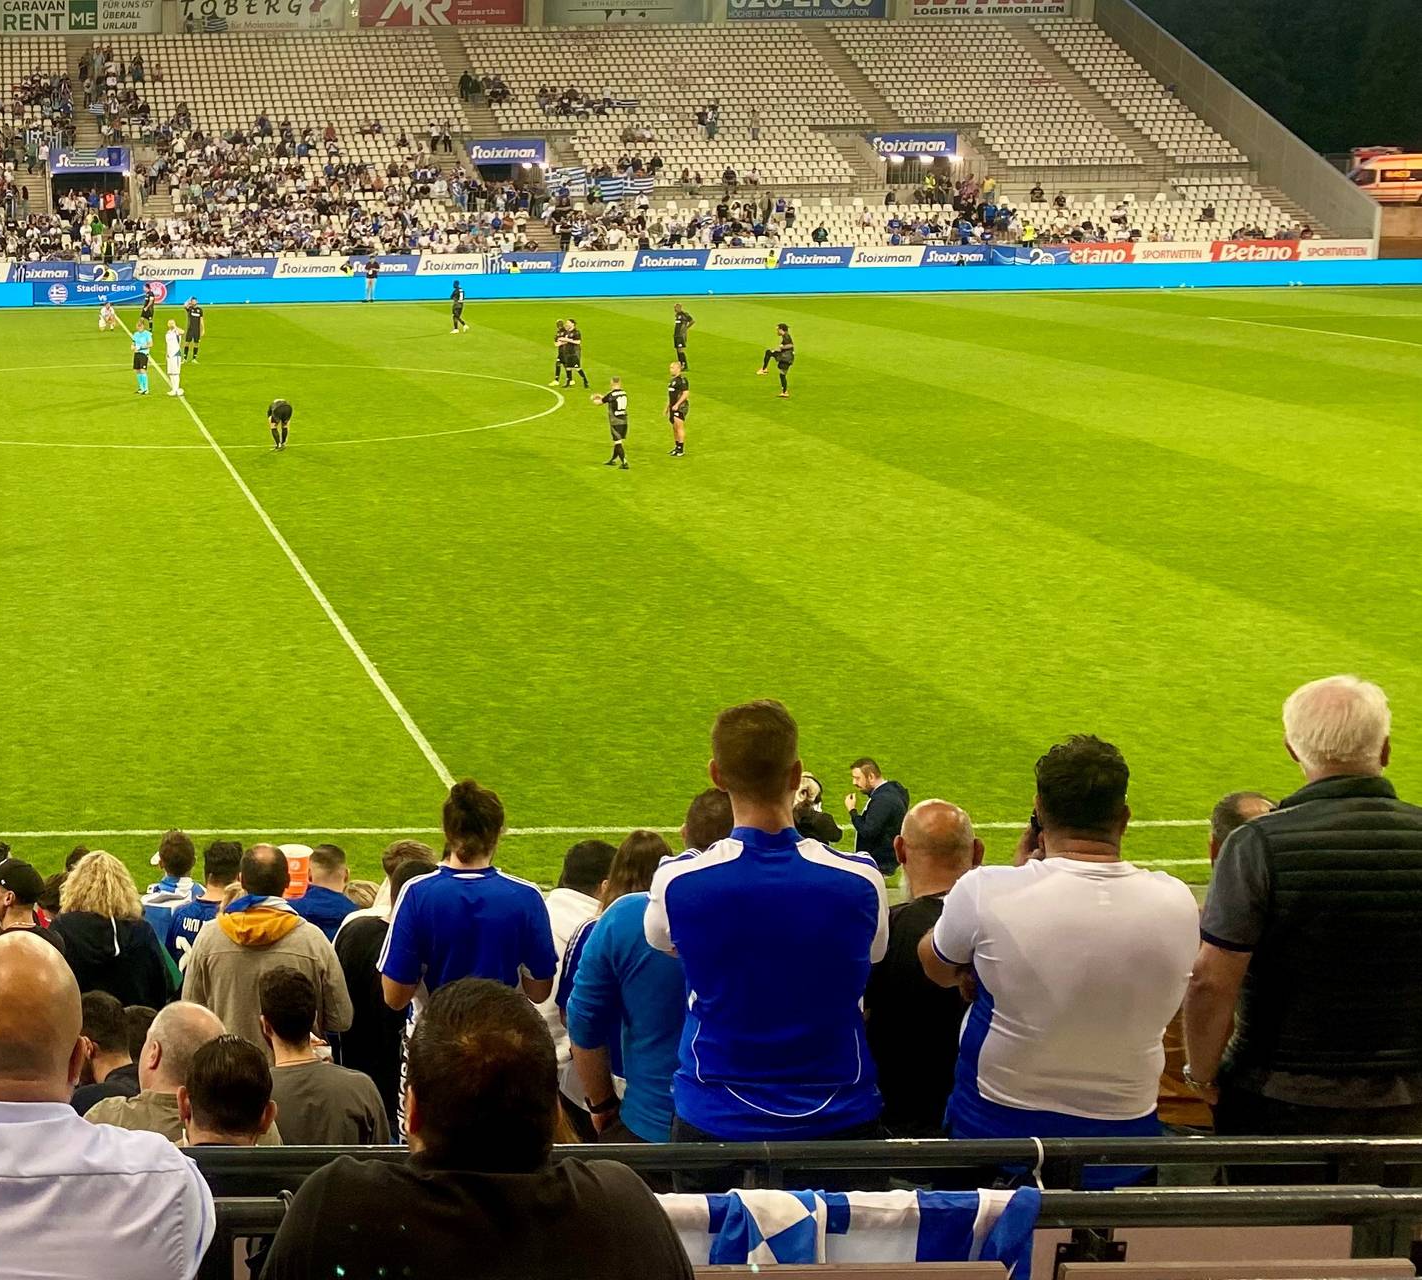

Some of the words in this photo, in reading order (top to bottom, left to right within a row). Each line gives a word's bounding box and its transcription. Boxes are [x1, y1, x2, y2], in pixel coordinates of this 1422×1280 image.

[3, 1, 65, 11] CARAVAN
[914, 7, 970, 15] LOGISTIK
[987, 5, 1064, 14] IMMOBILIEN
[762, 9, 804, 17] KOMPETENZ
[813, 9, 869, 17] KOMMUNIKATION
[3, 14, 65, 31] RENT
[71, 13, 96, 26] ME
[471, 145, 536, 159] Stoiximan
[856, 252, 911, 263] Stoiximan
[1069, 248, 1126, 263] etano
[1142, 249, 1202, 259] SPORTWETTEN
[1220, 244, 1291, 260] Betano
[568, 257, 624, 268] Stoiximan
[640, 256, 697, 267] Stoiximan
[784, 253, 841, 264] Stoiximan
[209, 264, 265, 275] Stoiximan
[280, 263, 335, 274] Stoiximan
[423, 260, 478, 271] Stoiximan
[139, 266, 194, 277] Stoiximan
[77, 284, 110, 293] Stadion
[111, 284, 136, 292] Essen
